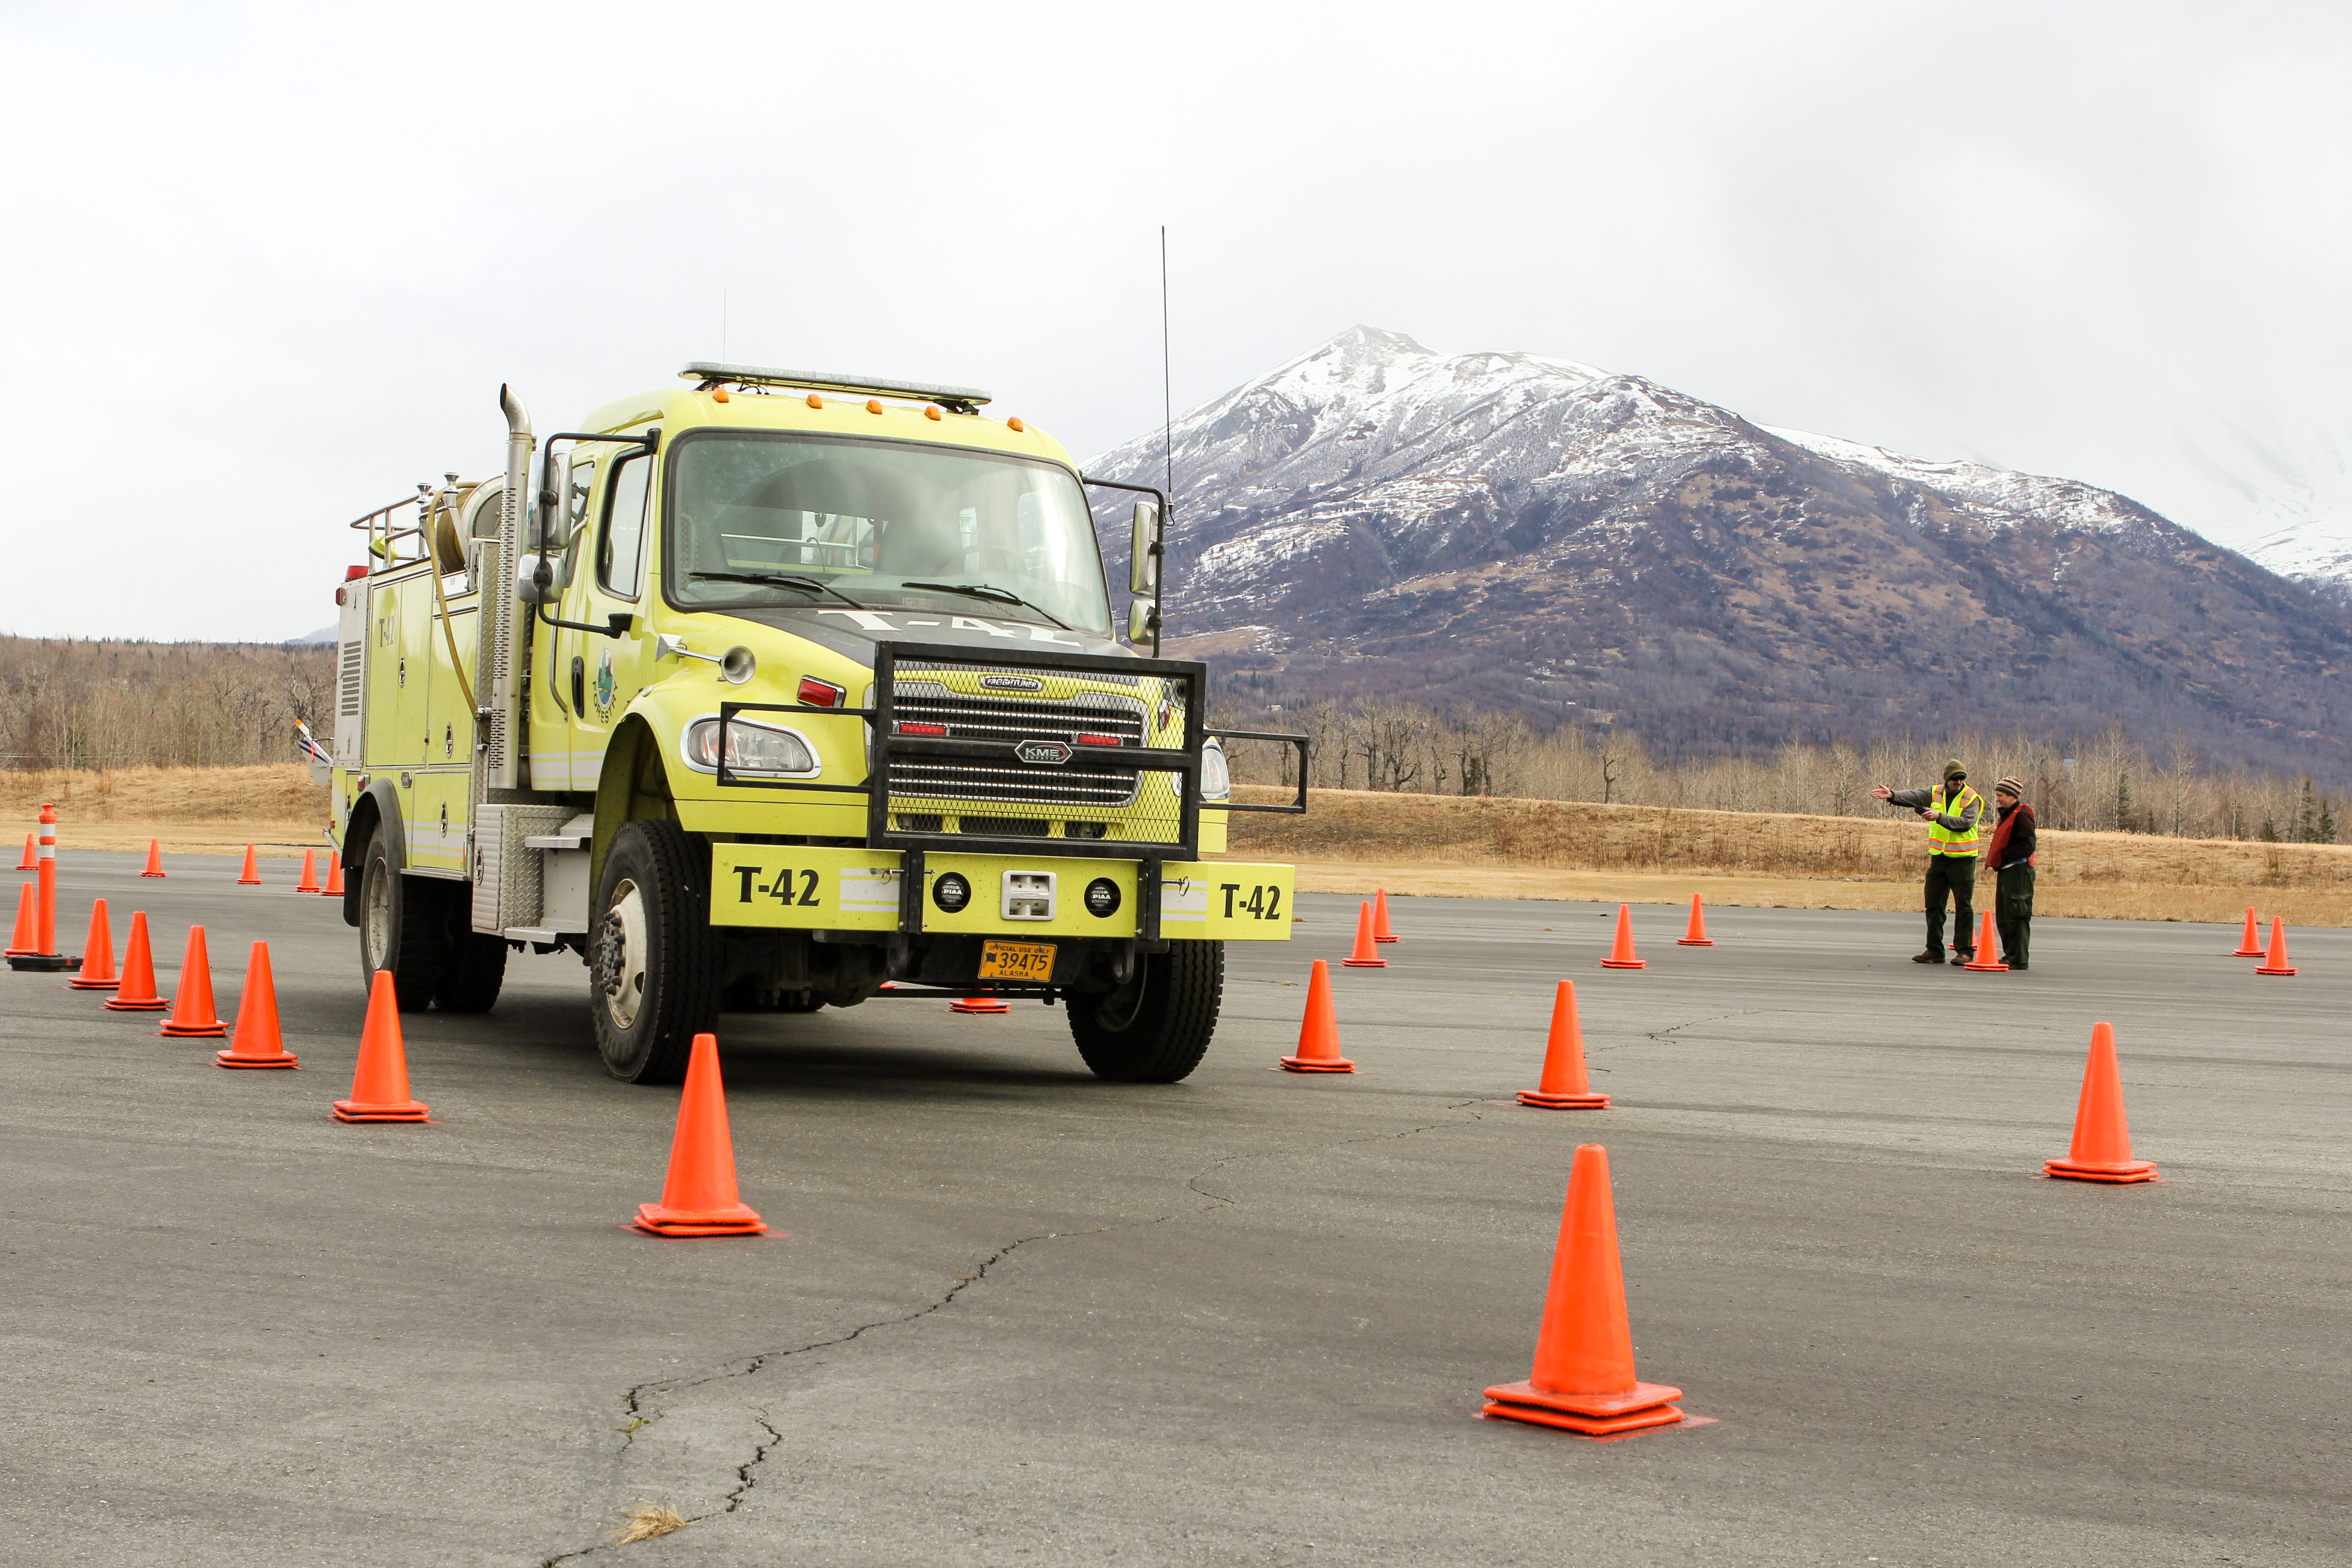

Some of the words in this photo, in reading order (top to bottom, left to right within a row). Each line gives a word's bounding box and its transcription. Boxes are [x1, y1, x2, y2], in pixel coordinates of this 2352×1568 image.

[379, 615, 394, 647] T-42
[817, 609, 1082, 647] T-42
[987, 679, 1037, 688] FREIGHTLINER
[1025, 748, 1059, 757] KME
[733, 866, 820, 906] T-42
[1220, 883, 1280, 920] T-42
[999, 952, 1049, 971] 39475
